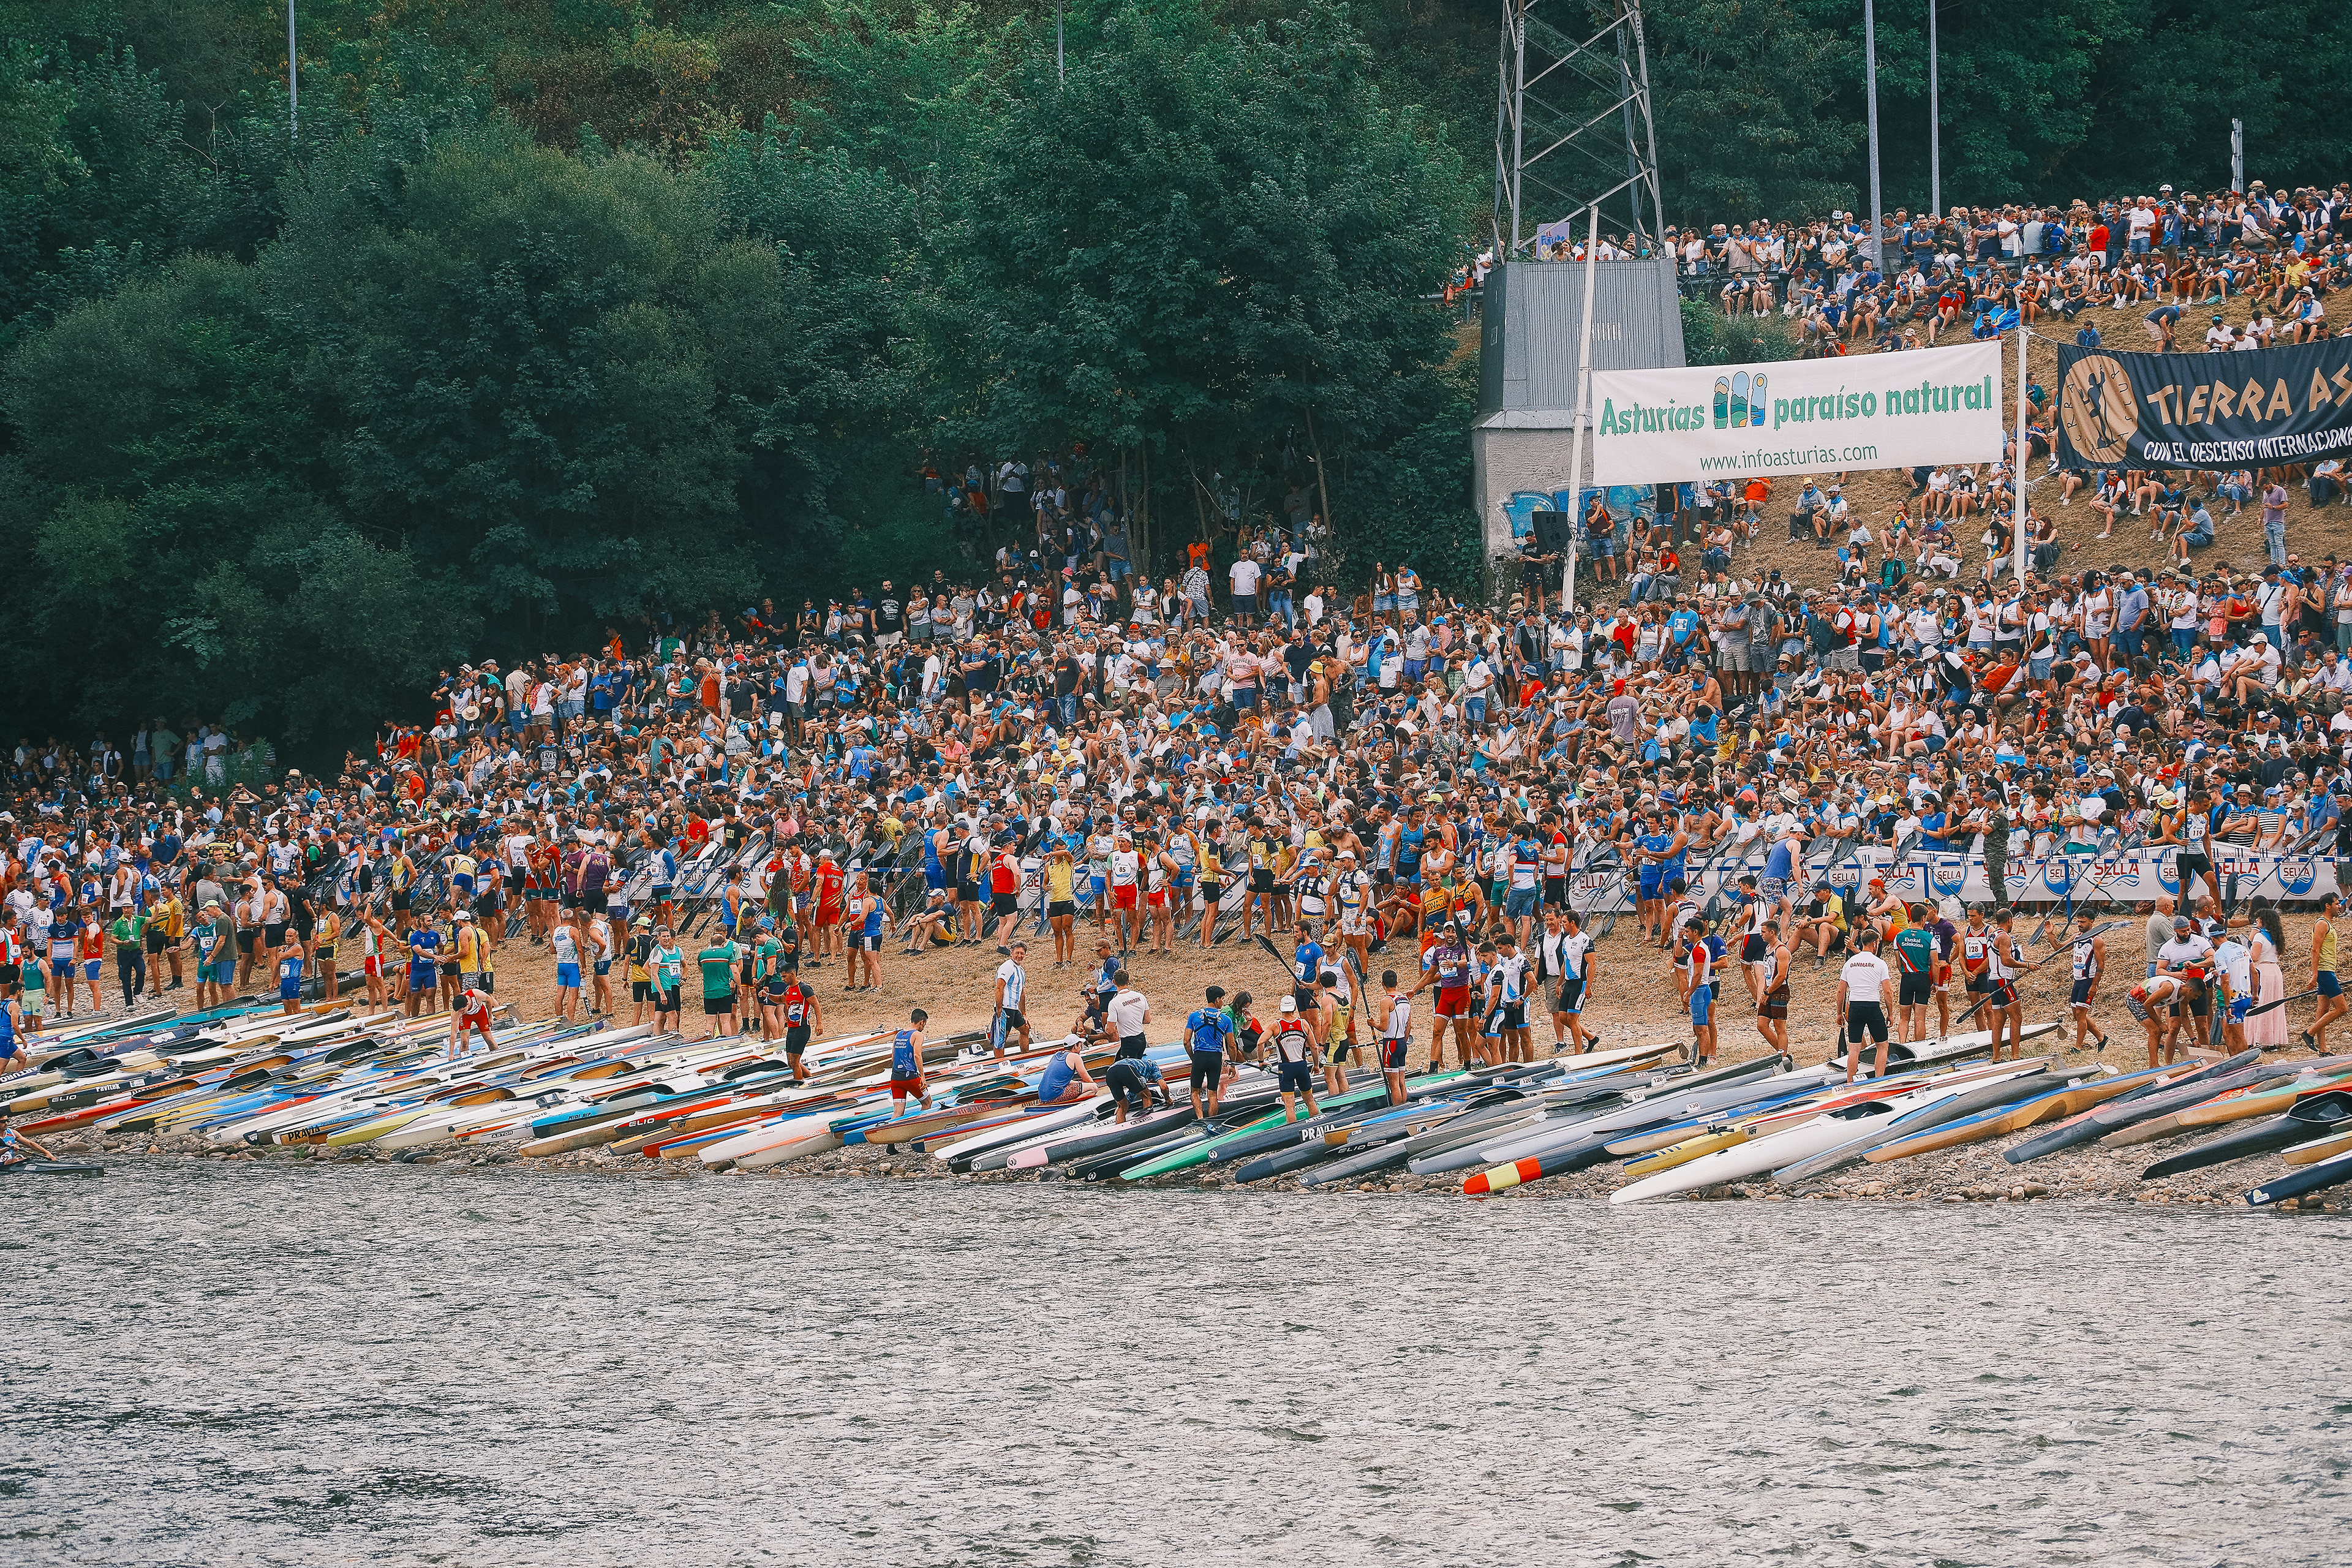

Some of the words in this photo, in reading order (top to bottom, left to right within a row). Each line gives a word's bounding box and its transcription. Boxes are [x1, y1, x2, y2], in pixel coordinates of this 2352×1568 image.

[1599, 398, 1705, 436] Asturias
[1774, 385, 1877, 431] paraíso
[1886, 374, 1992, 417] natural
[2147, 377, 2293, 426] TIERRA
[2144, 441, 2171, 462] CON
[2174, 443, 2189, 462] EL
[2191, 439, 2255, 462] DESCENSO
[1699, 443, 1878, 471] www.infoasturias.com
[1937, 870, 1961, 880] SELLA
[2049, 869, 2075, 878] SELA
[2163, 868, 2179, 876] SEL
[1572, 874, 1606, 889] ELLA
[1832, 873, 1856, 883] SELLA
[1121, 997, 1142, 1007] DANMARK
[1931, 1042, 1977, 1057] eliokayaks.com
[458, 1060, 474, 1069] RACING
[0, 1066, 39, 1083] ARTURO
[341, 1091, 360, 1101] KNYSNA
[360, 1085, 377, 1095] RACING
[971, 1104, 991, 1114] RUSH
[628, 1118, 655, 1128] ELIO
[1131, 1117, 1153, 1126] ASTOR
[1305, 1113, 1327, 1123] ASTOR
[1183, 1127, 1204, 1136] ASTOR
[1338, 1144, 1366, 1154] ELIO
